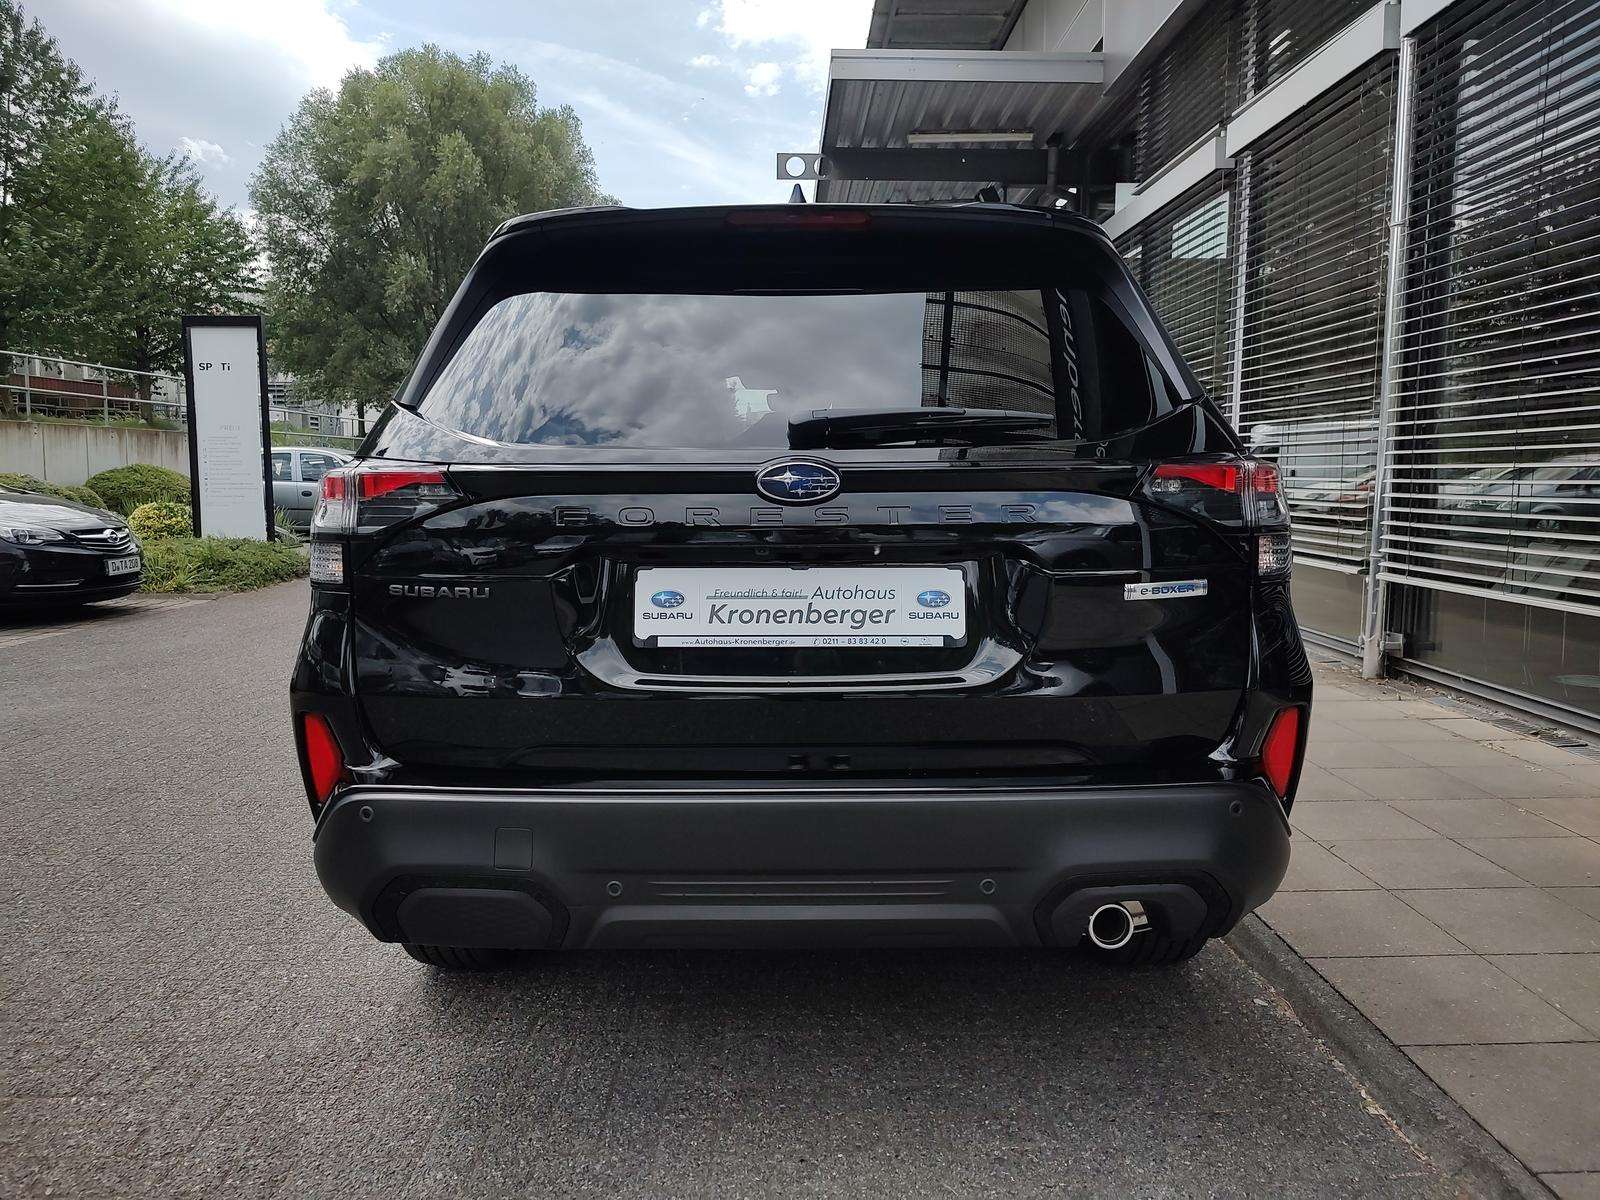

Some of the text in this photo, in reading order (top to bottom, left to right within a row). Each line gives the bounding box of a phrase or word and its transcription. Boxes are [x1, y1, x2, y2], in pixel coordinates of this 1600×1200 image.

[554, 504, 1040, 527] FORESTER
[388, 584, 491, 599] SUBARU
[713, 588, 804, 599] Freundlich & fair!
[811, 584, 896, 600] Autohaus
[1141, 584, 1196, 596] e-BOXER
[642, 612, 693, 620] SUBARU
[707, 602, 897, 630] Kronenberger
[908, 611, 960, 620] SUBARU
